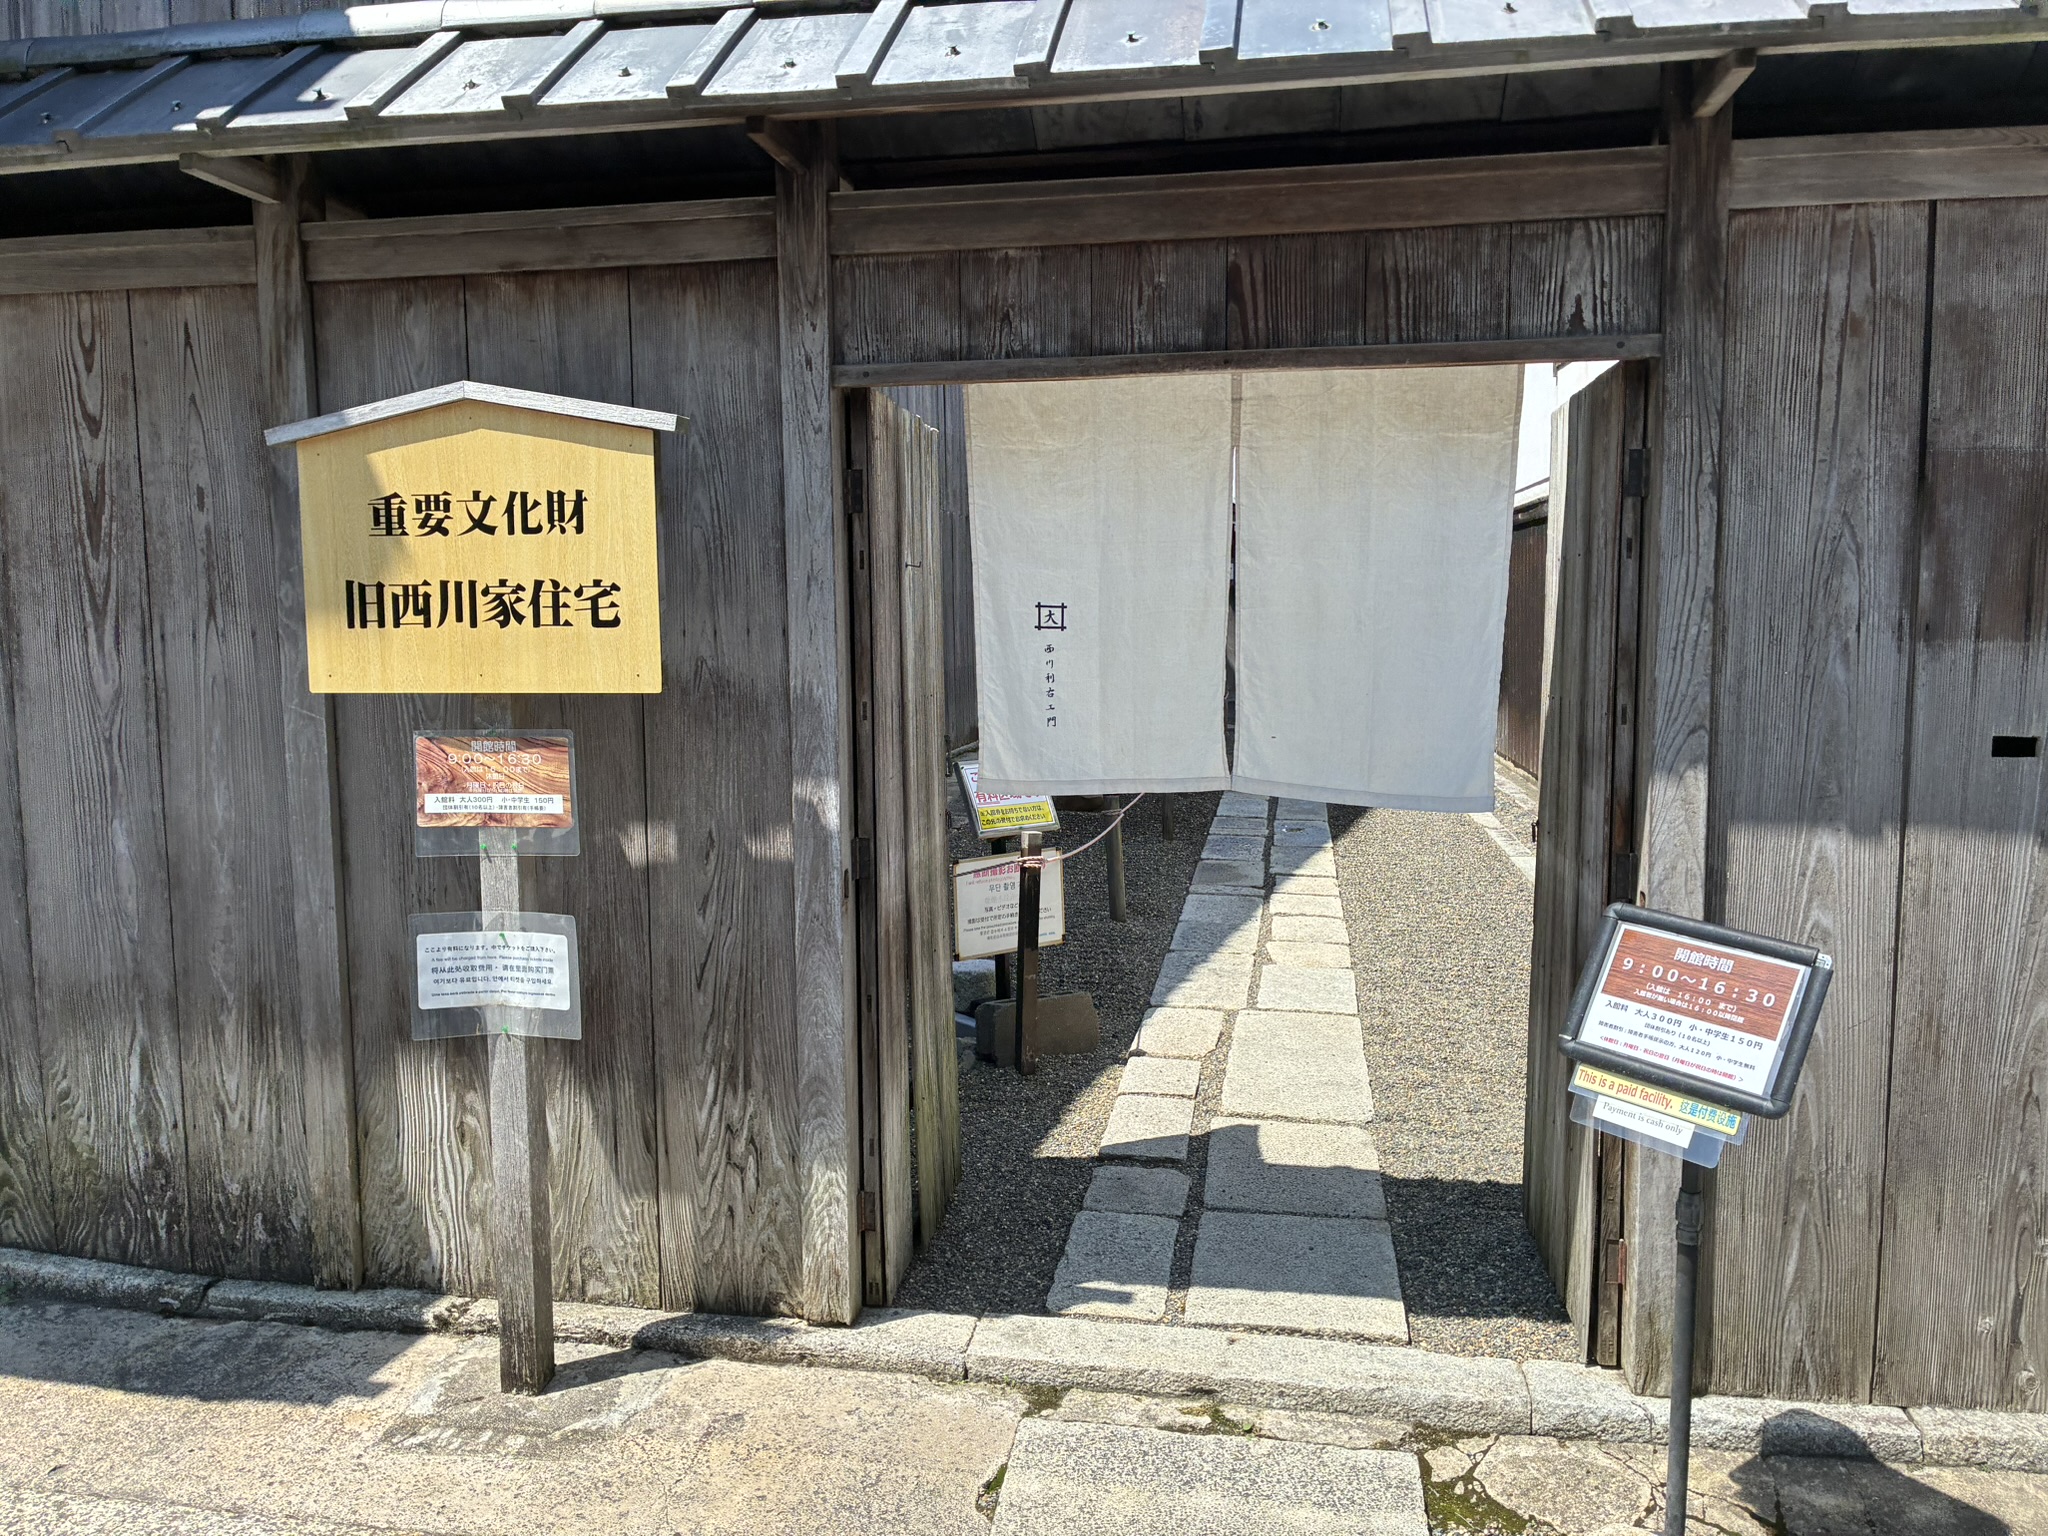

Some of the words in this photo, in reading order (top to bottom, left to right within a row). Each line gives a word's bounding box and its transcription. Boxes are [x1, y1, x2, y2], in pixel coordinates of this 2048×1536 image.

[368, 489, 589, 537] 重要文化財
[345, 579, 622, 630] 旧西川家住宅
[471, 740, 517, 753] 開館時間
[434, 796, 455, 804] 入館料
[459, 796, 493, 804] 大人300円
[534, 797, 554, 805] 150円
[1673, 947, 1735, 974] 開館時間
[1605, 999, 1629, 1013] 入館料
[1634, 1008, 1683, 1028] 大人300円
[1578, 1068, 1597, 1085] This
[1599, 1074, 1607, 1087] is
[1608, 1080, 1615, 1089] a
[1616, 1078, 1638, 1099] paid
[1638, 1084, 1674, 1109] facility.
[1602, 1101, 1636, 1120] Payment
[1637, 1111, 1645, 1121] is
[1646, 1114, 1664, 1128] cash
[1665, 1121, 1684, 1136] only
[1679, 1098, 1738, 1130] 这是付费设施
